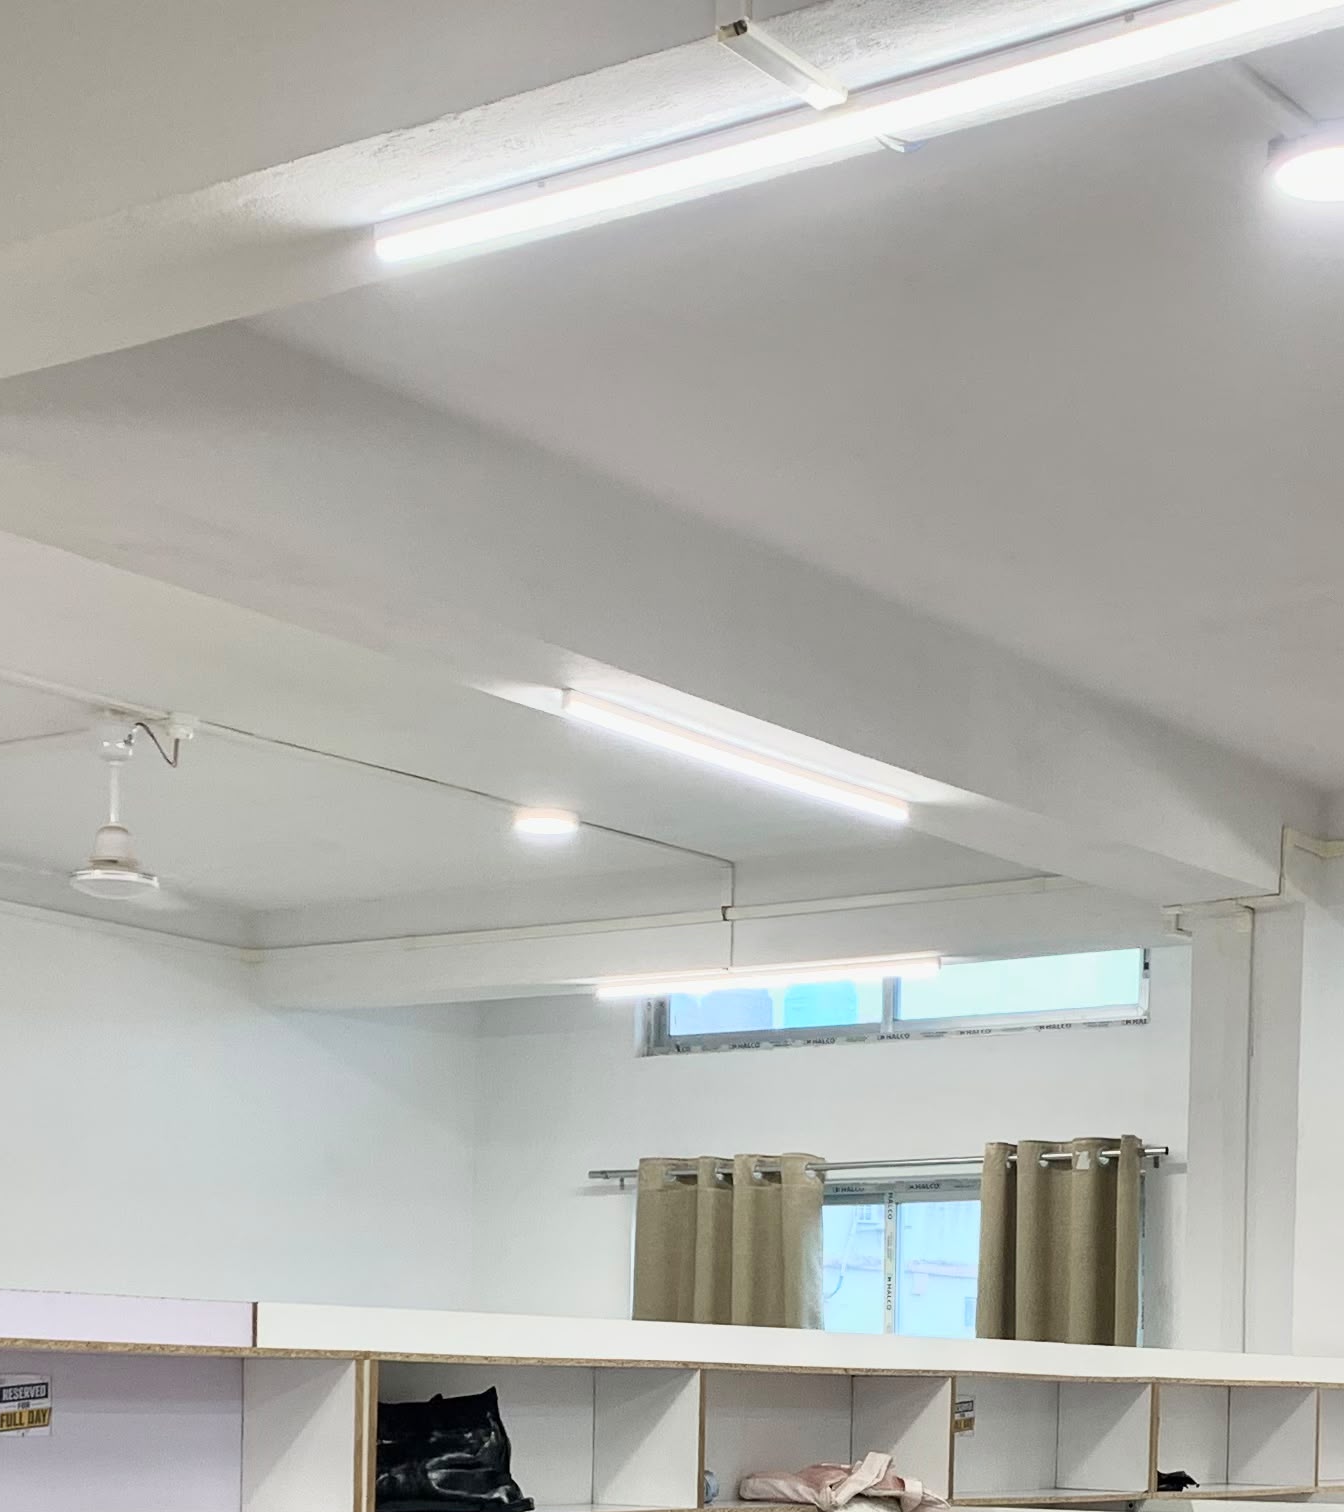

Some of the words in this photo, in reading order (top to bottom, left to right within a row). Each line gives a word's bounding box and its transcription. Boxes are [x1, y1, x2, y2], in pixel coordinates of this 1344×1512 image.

[2, 1384, 46, 1401] RESERVED
[0, 1411, 25, 1428] FULL
[27, 1408, 48, 1425] DAY
